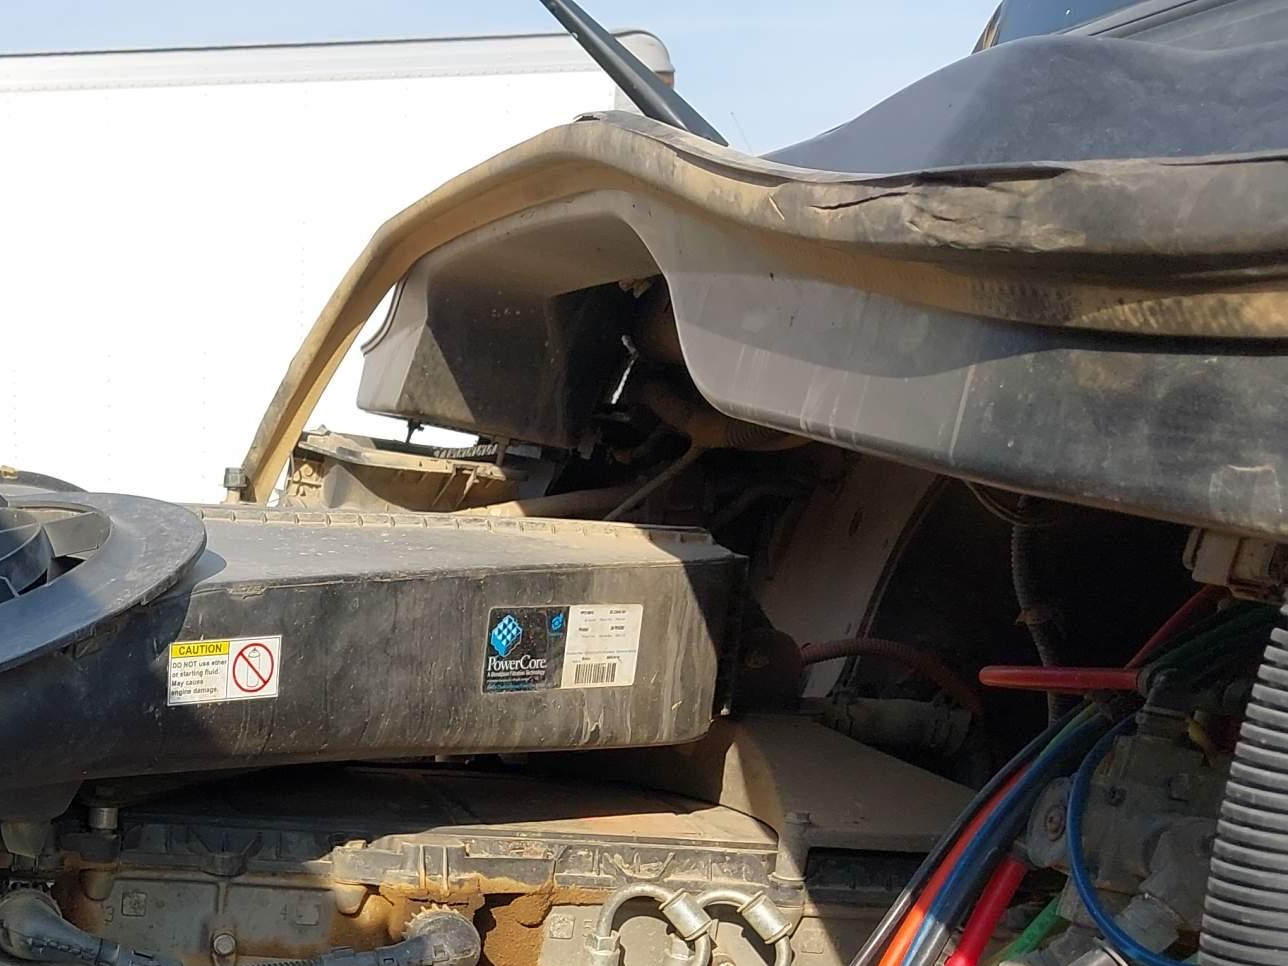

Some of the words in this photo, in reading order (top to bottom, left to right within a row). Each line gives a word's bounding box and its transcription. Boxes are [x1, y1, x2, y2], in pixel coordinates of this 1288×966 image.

[178, 644, 222, 655] CAUTION
[183, 660, 197, 668] NOT
[180, 670, 203, 678] starting
[172, 680, 184, 688] May
[171, 689, 192, 697] engine
